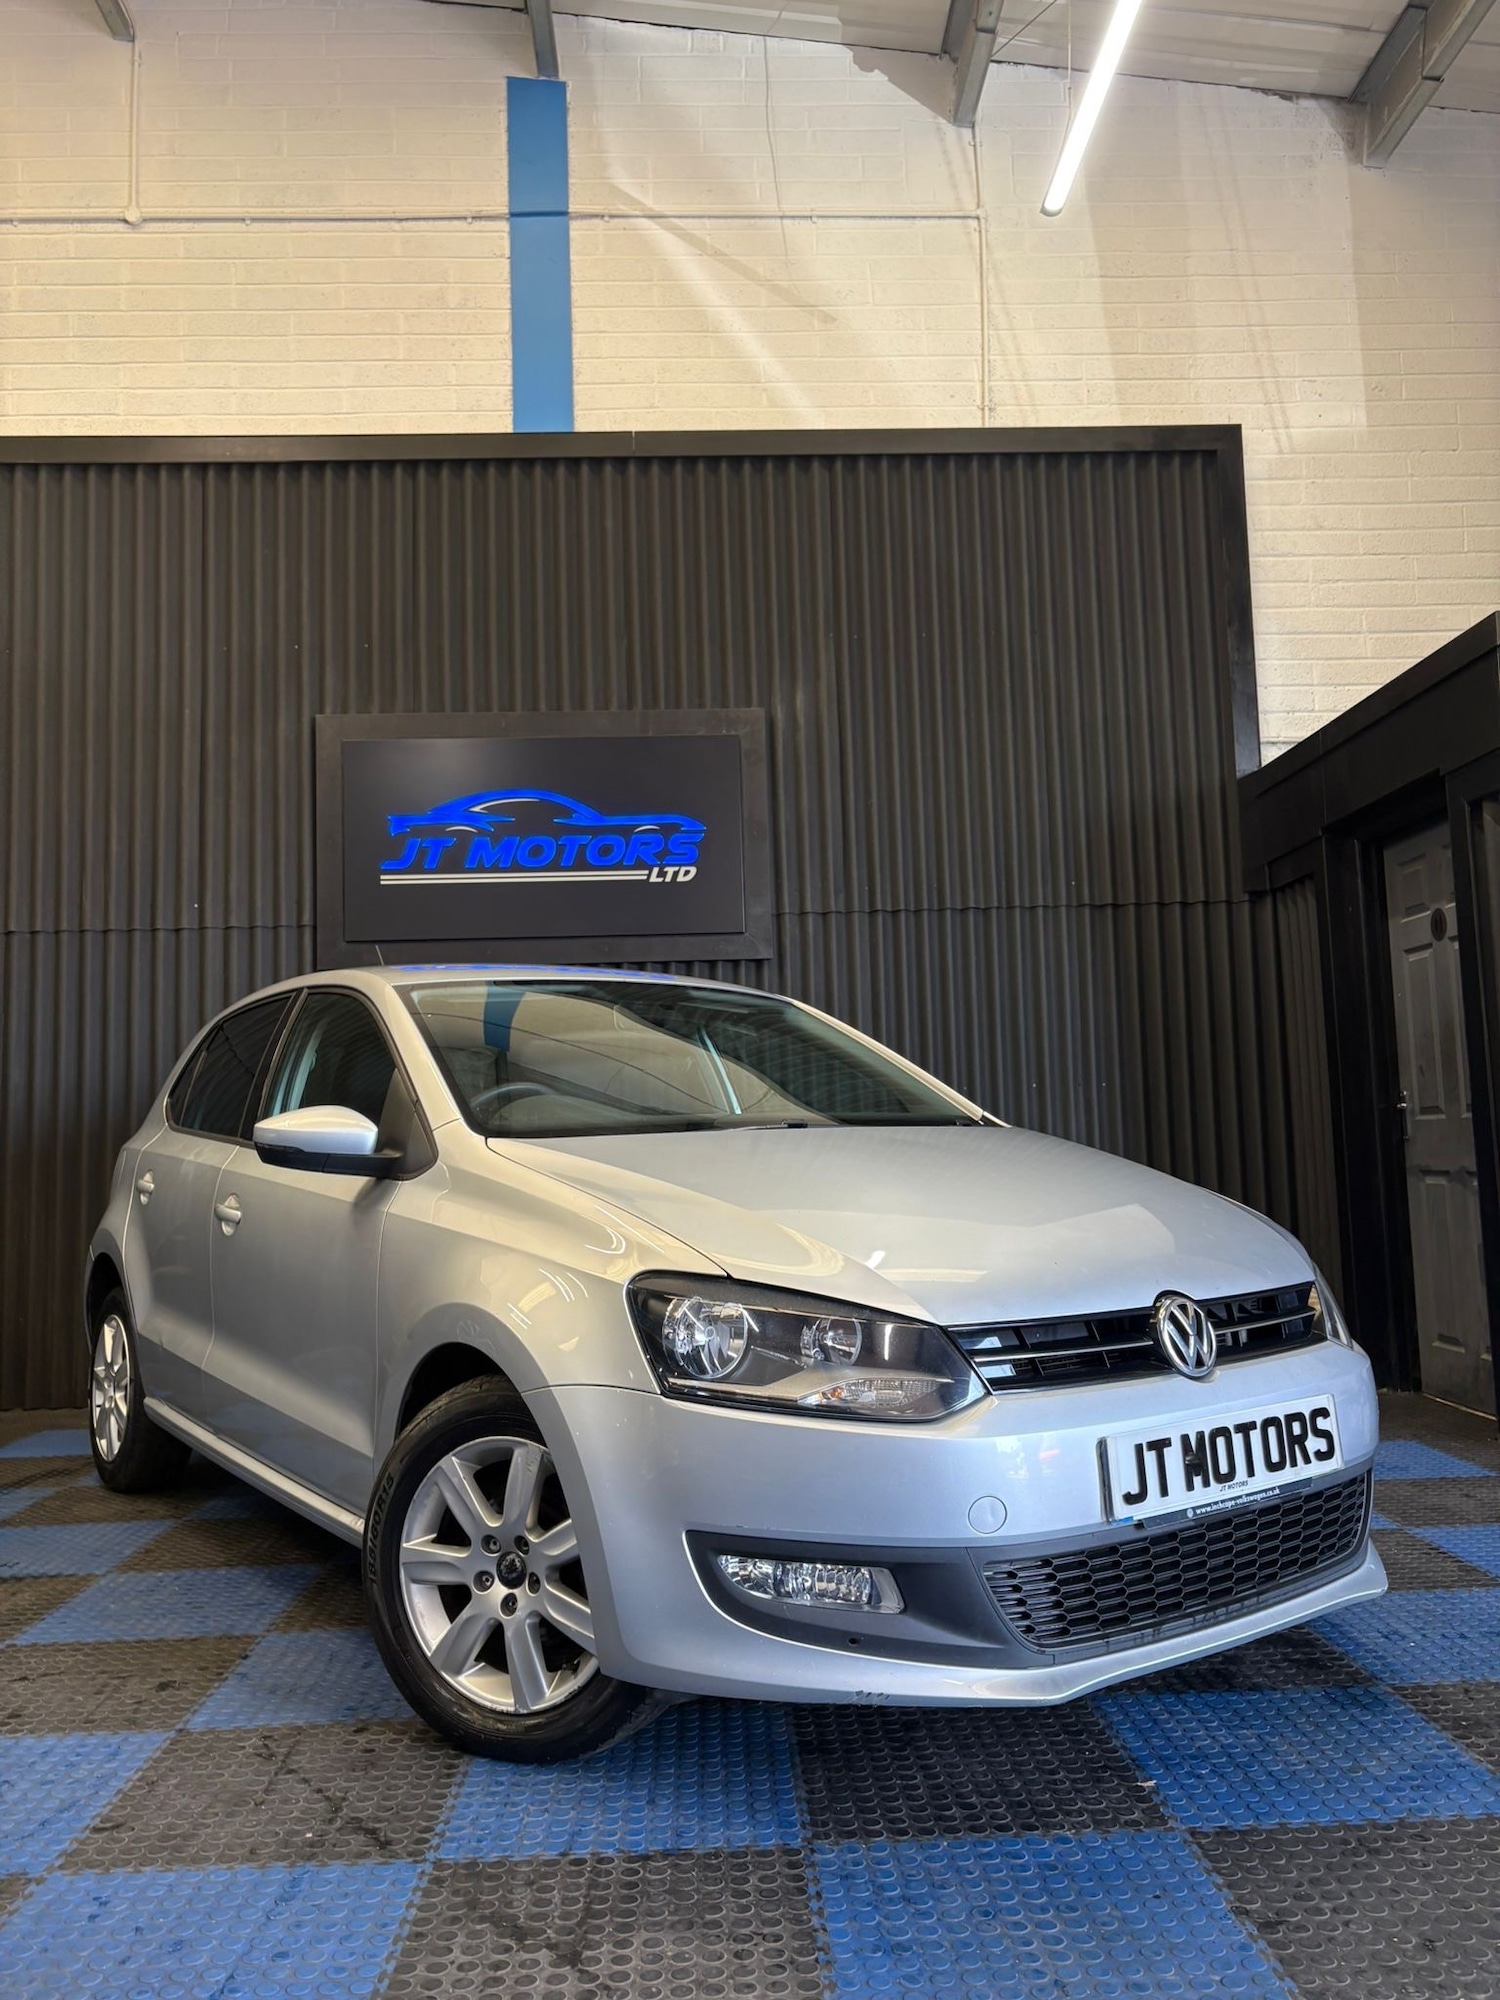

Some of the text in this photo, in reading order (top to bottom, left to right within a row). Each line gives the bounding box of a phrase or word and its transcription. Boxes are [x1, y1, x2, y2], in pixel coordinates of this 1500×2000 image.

[380, 832, 706, 871] JT MOTORS
[649, 866, 698, 883] LTD
[1121, 1406, 1335, 1506] JT MOTORS
[1227, 1480, 1249, 1490] MOTORS
